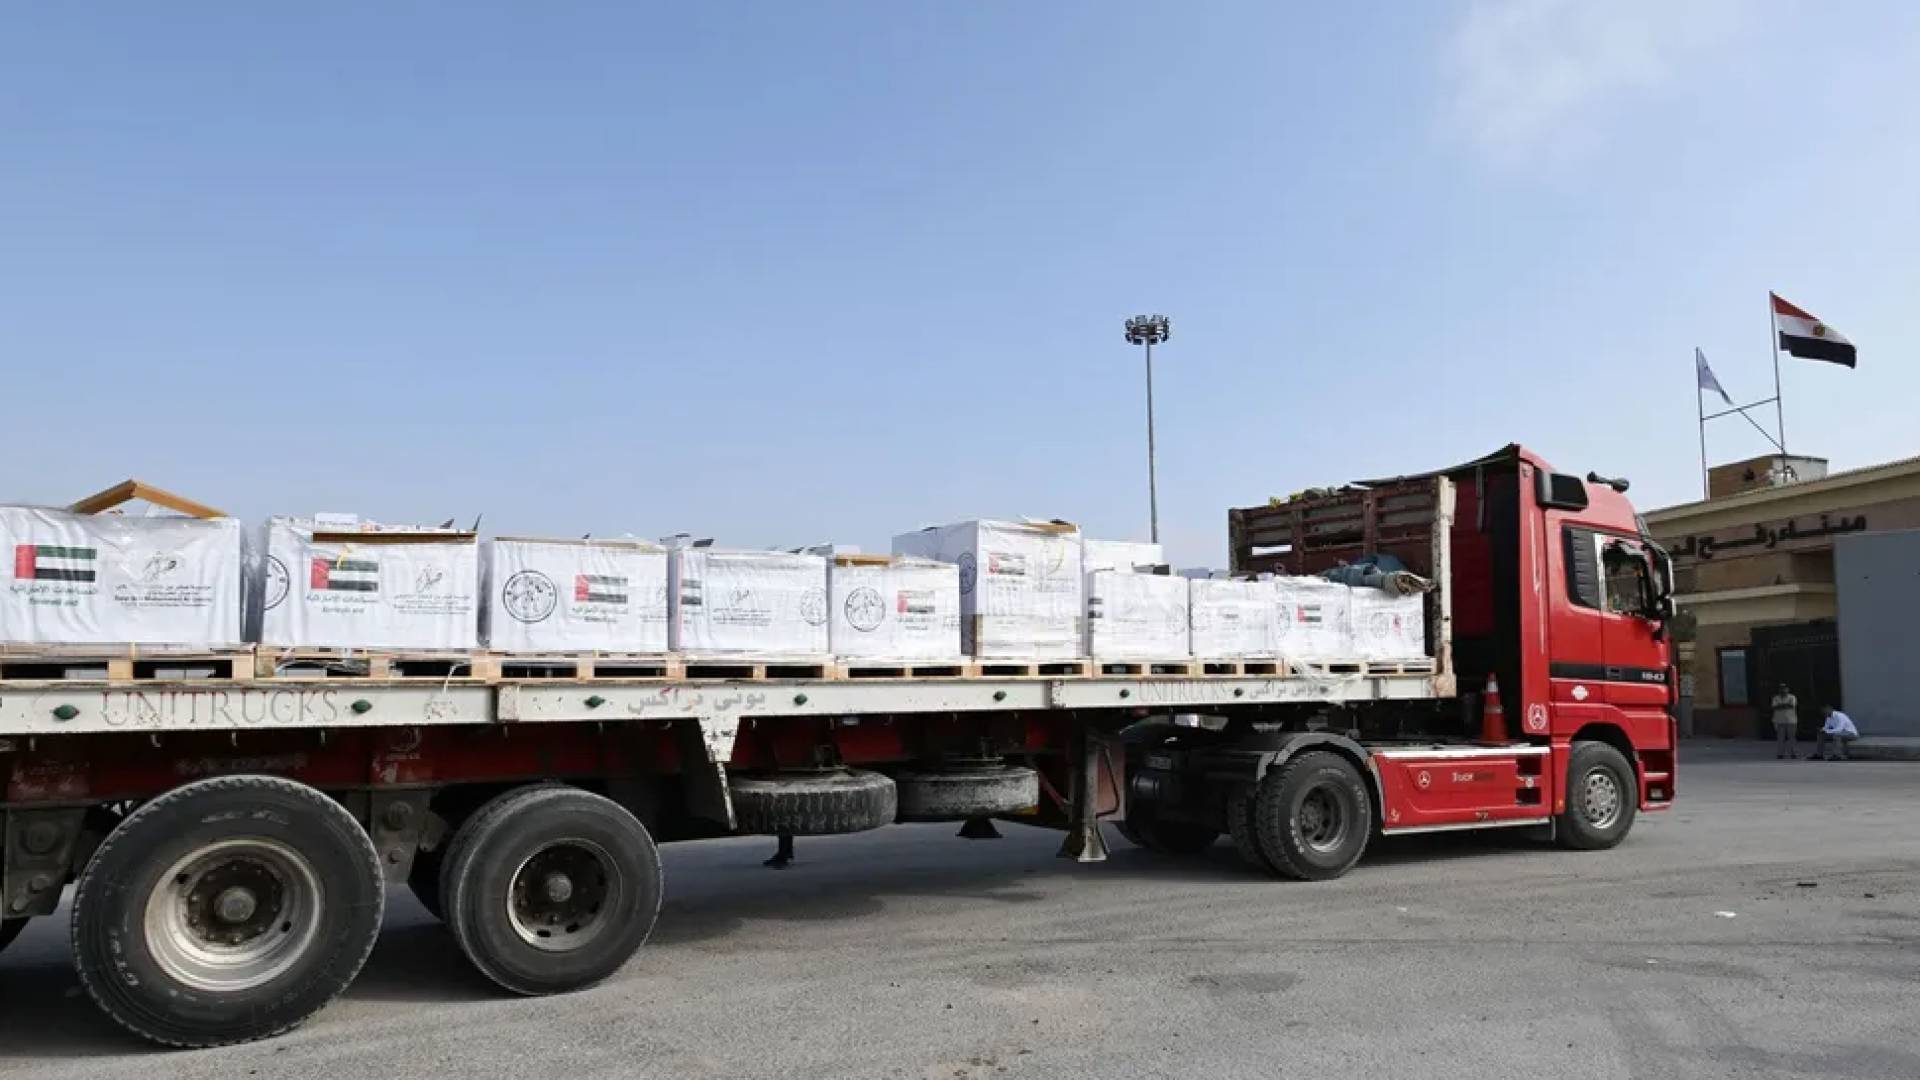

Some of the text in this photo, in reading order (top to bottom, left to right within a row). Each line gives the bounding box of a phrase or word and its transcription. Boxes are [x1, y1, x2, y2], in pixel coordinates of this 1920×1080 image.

[1698, 522, 1776, 559] رفح
[101, 690, 338, 727] UNITRUCKS
[1136, 679, 1235, 702] UNITRUCKS
